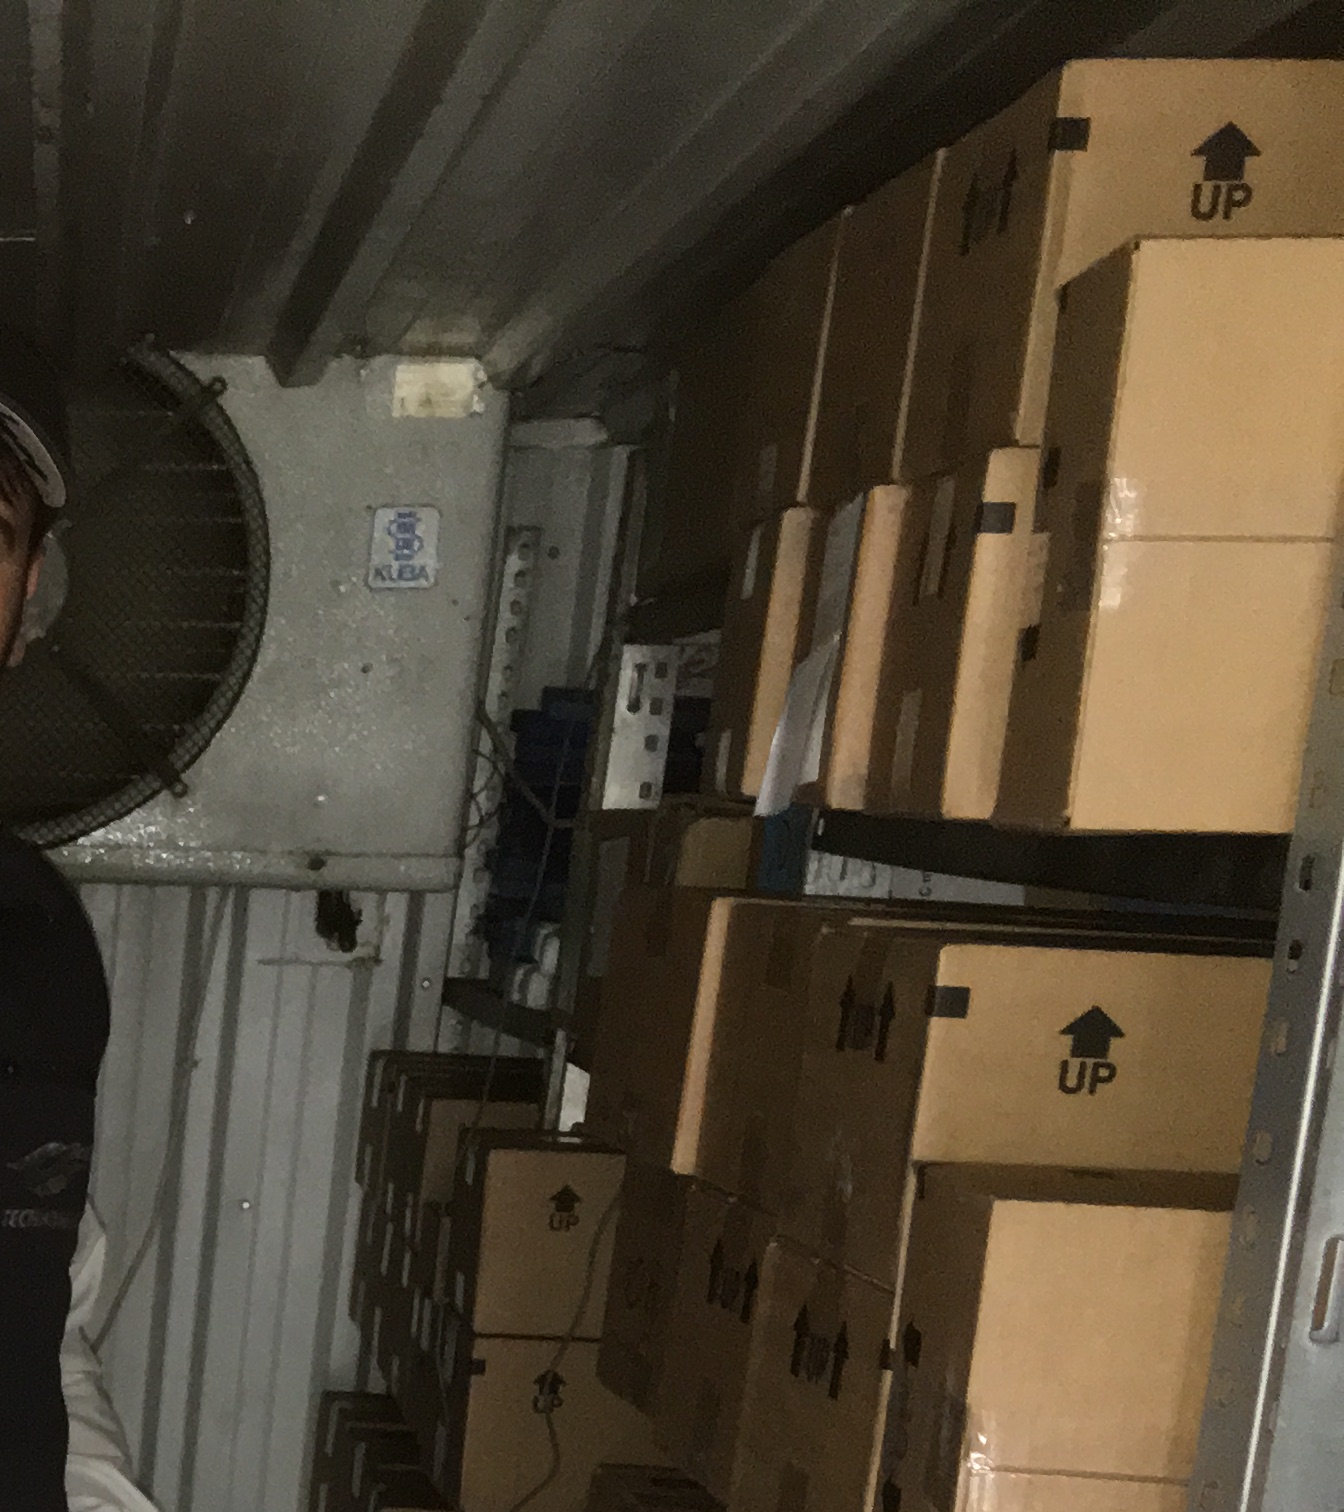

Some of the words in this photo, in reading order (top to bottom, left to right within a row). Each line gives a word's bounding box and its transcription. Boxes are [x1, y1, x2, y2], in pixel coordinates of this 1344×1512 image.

[1191, 181, 1253, 221] UP
[1059, 1059, 1118, 1095] UP
[549, 1214, 580, 1233] UP
